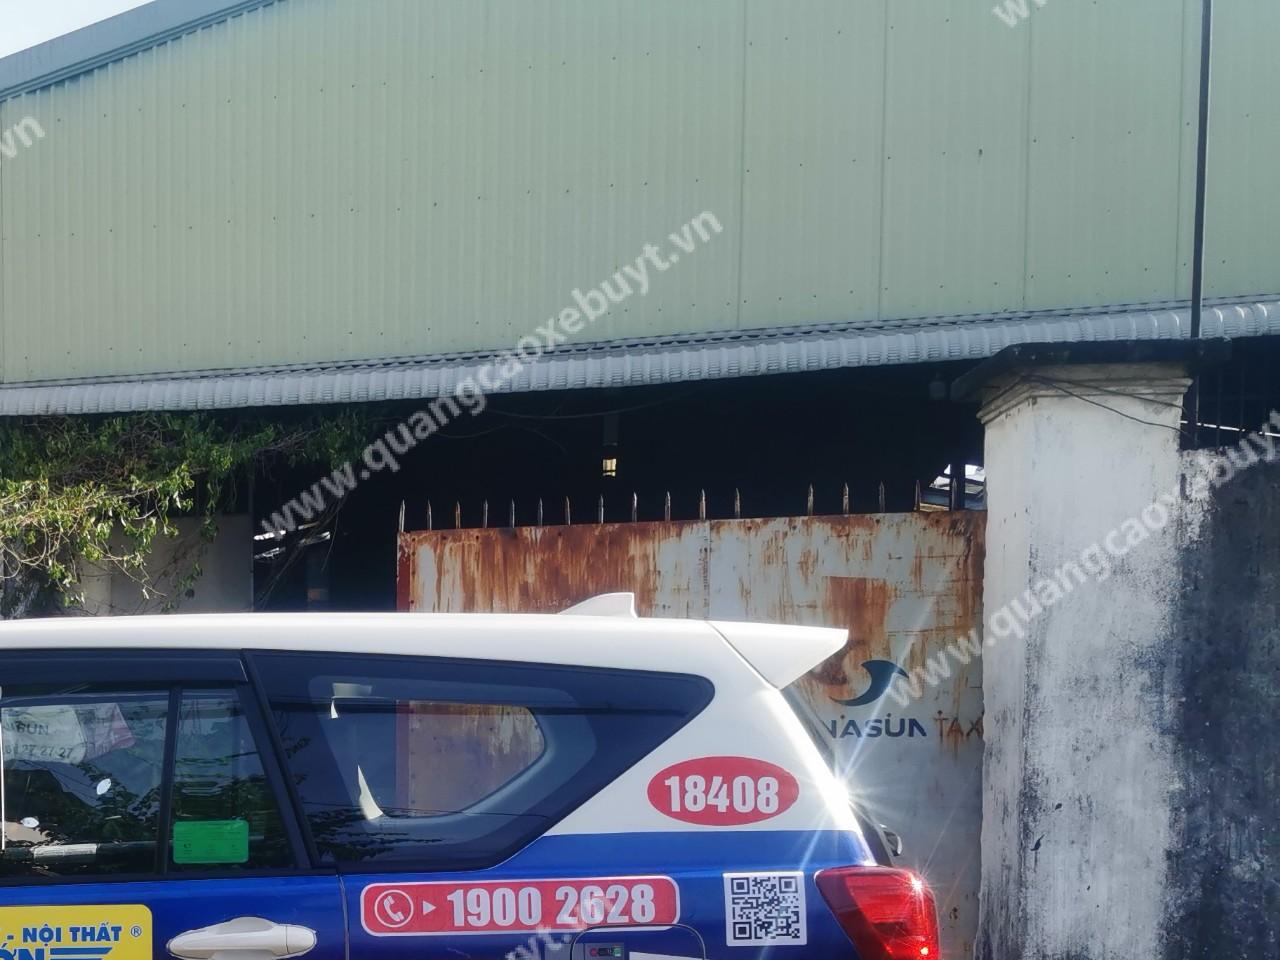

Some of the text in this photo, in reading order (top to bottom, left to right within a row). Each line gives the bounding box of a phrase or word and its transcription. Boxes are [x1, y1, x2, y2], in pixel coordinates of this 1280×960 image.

[822, 714, 984, 740] NASUN TAX
[664, 775, 779, 814] 18408
[447, 883, 656, 927] 1900 2628
[22, 923, 62, 947] NỘI
[69, 921, 122, 943] THẤT
